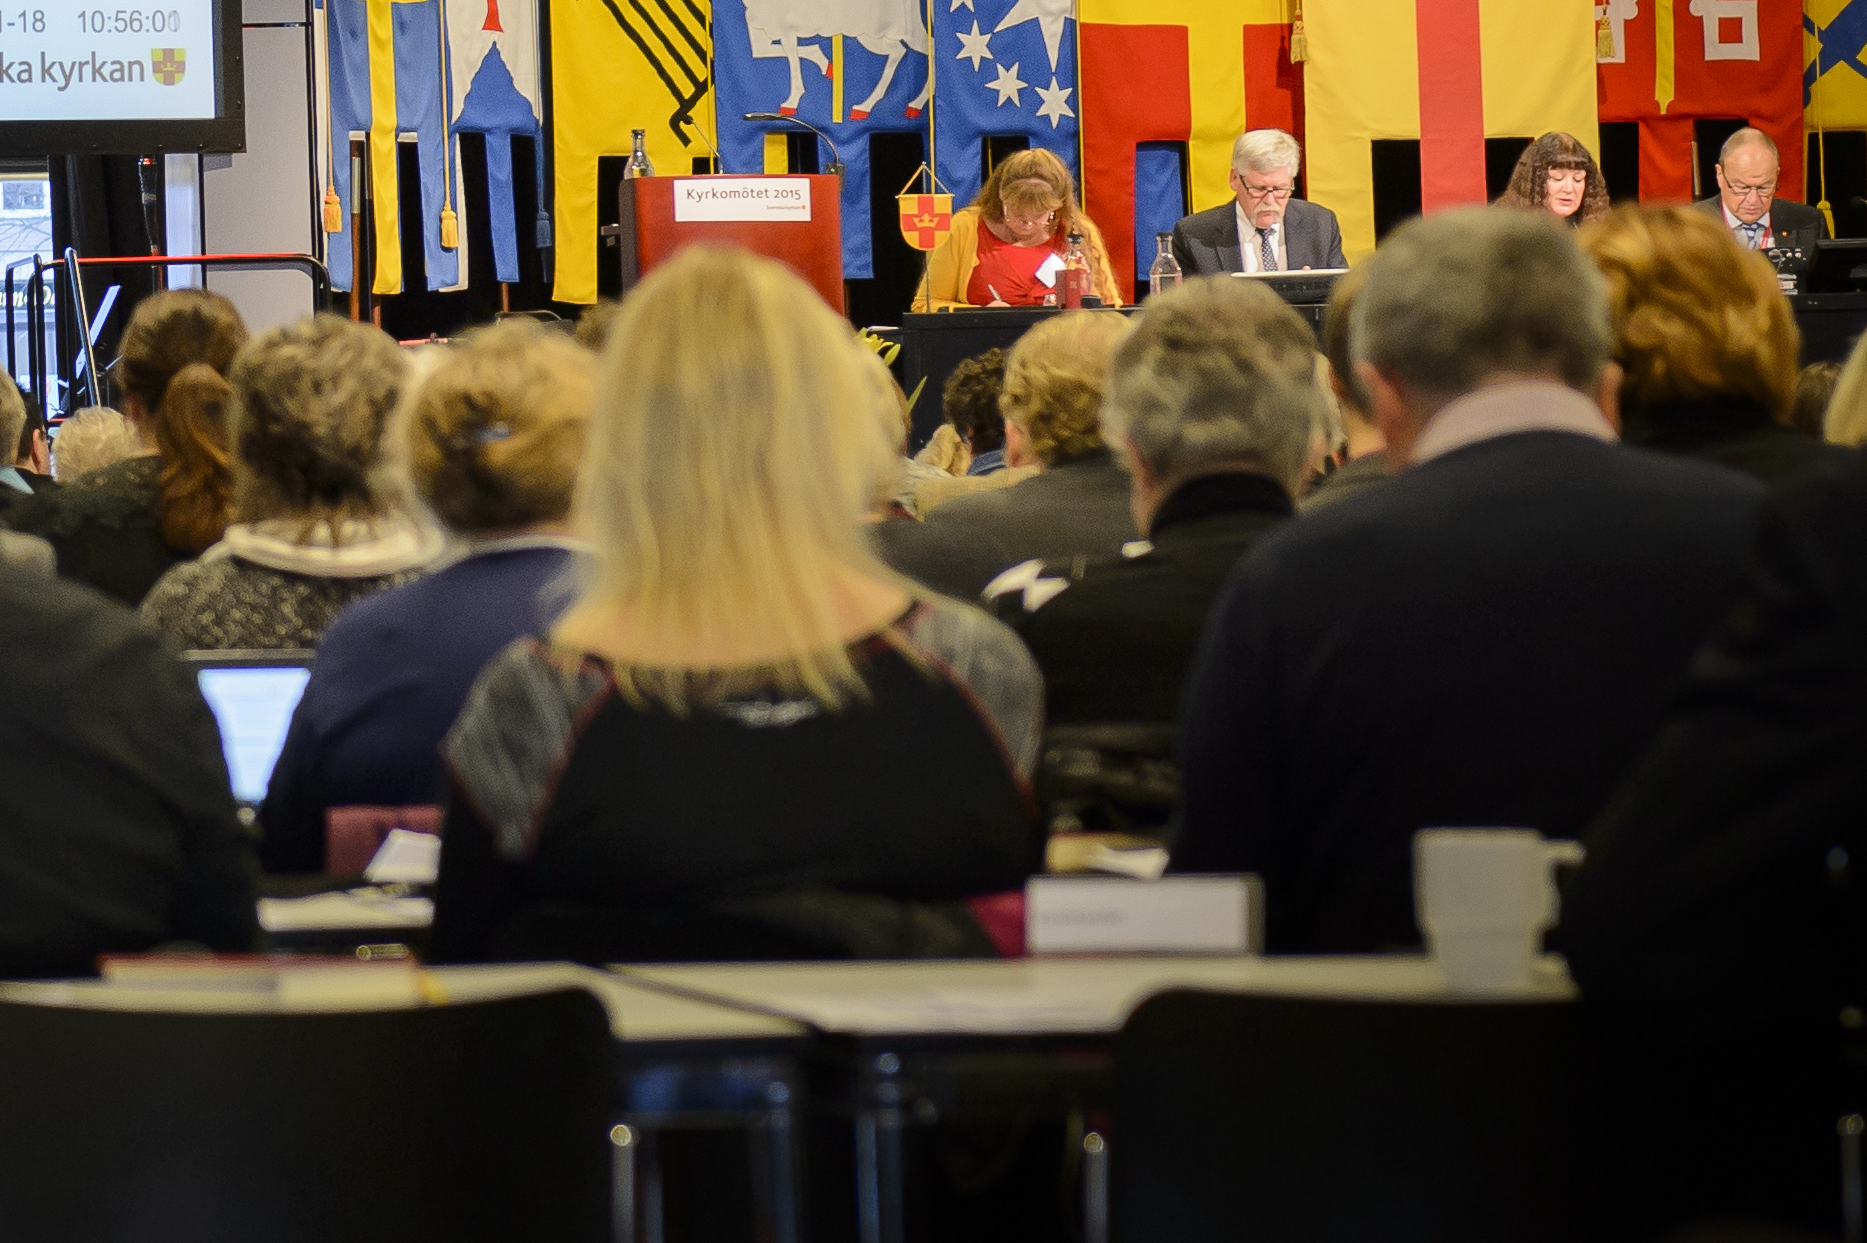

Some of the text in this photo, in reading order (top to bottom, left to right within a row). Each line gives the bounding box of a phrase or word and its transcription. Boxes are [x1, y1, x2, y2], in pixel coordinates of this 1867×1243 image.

[40, 50, 146, 92] kyrkan
[686, 187, 802, 203] Kyrkomötet 2015
